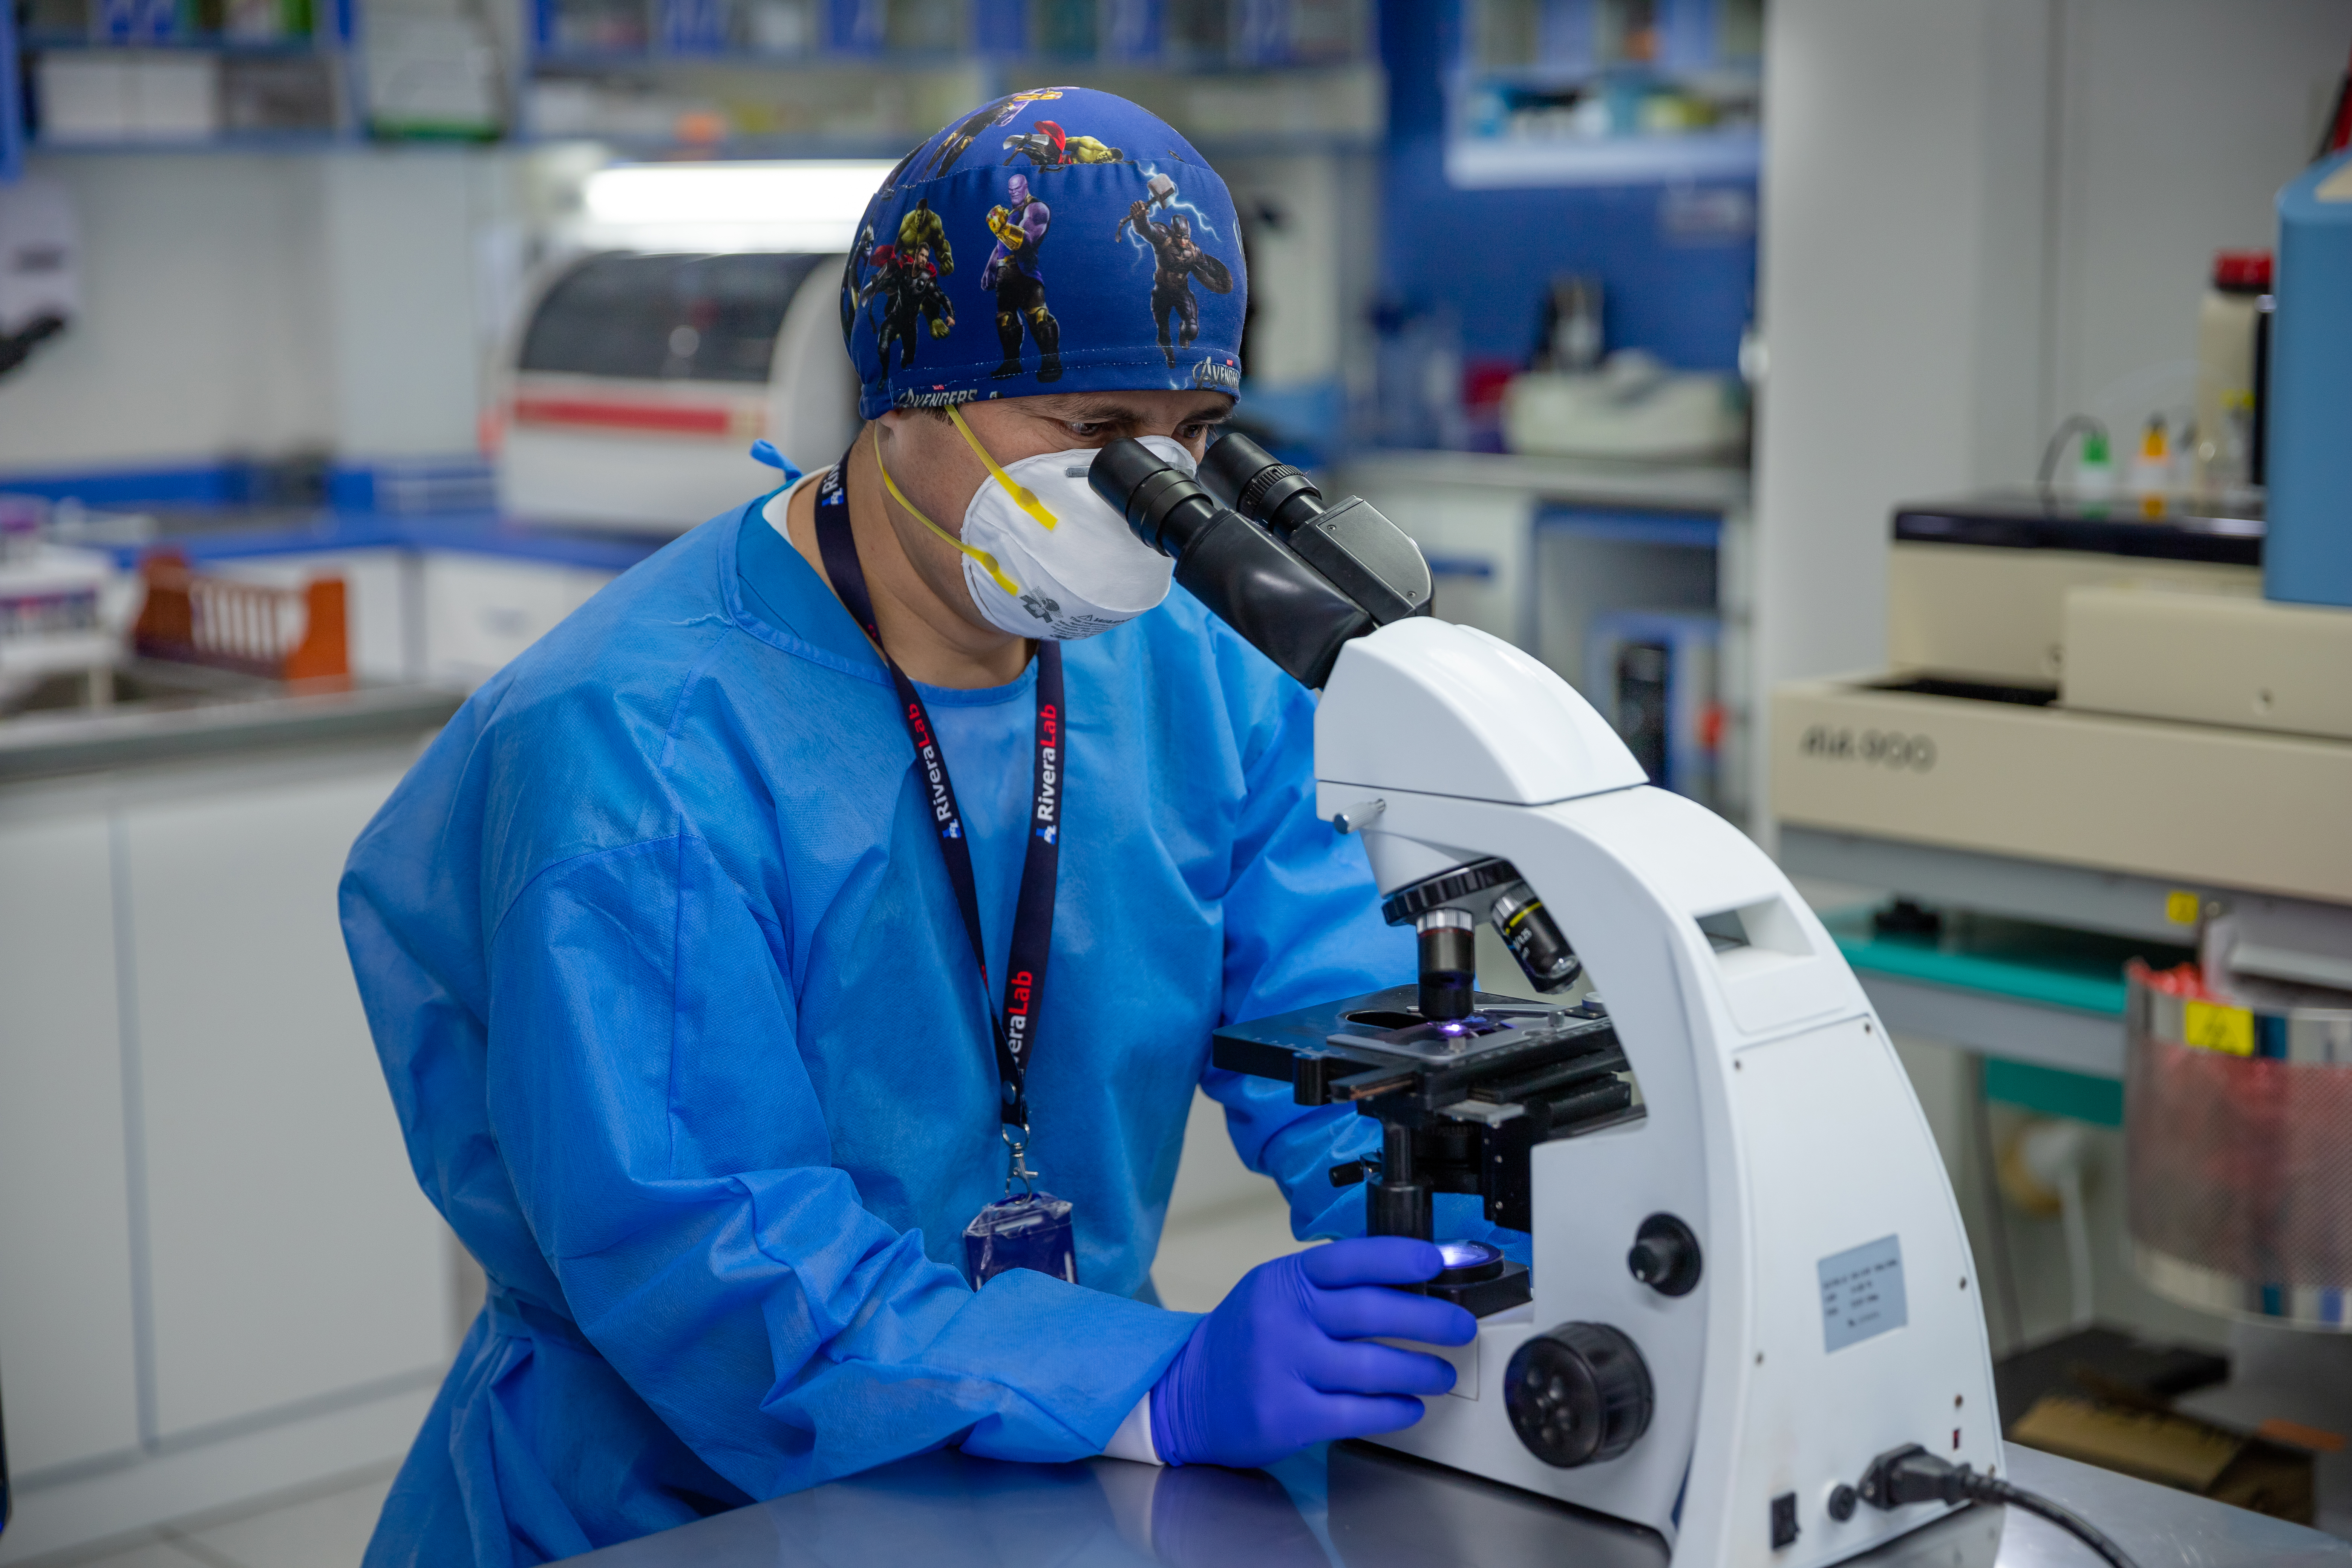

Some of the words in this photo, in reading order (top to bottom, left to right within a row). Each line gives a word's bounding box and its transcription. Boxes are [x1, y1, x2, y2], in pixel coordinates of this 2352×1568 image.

[909, 704, 952, 822] RiveraLab
[1037, 704, 1057, 822] RiveraLab
[1008, 971, 1033, 1065] eraLab
